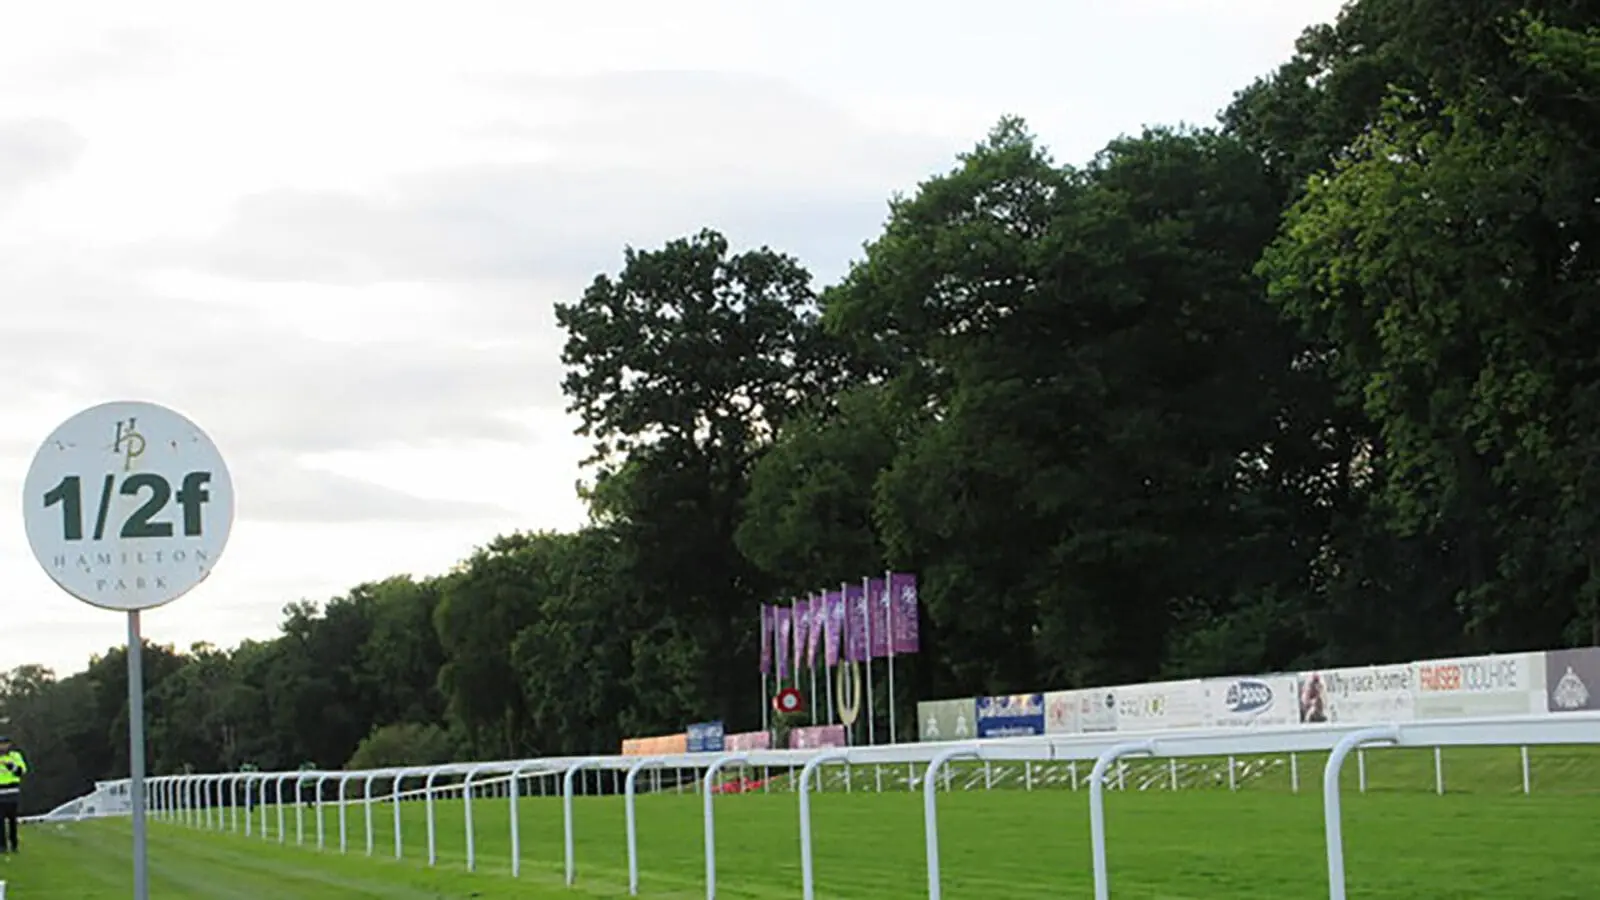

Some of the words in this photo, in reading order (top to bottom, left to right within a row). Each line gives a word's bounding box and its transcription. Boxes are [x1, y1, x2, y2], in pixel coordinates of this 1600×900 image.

[43, 471, 212, 541] 1/2f
[53, 549, 209, 569] HAMILTON
[96, 576, 168, 592] PARK
[1324, 671, 1349, 698] Why
[1351, 675, 1374, 693] race
